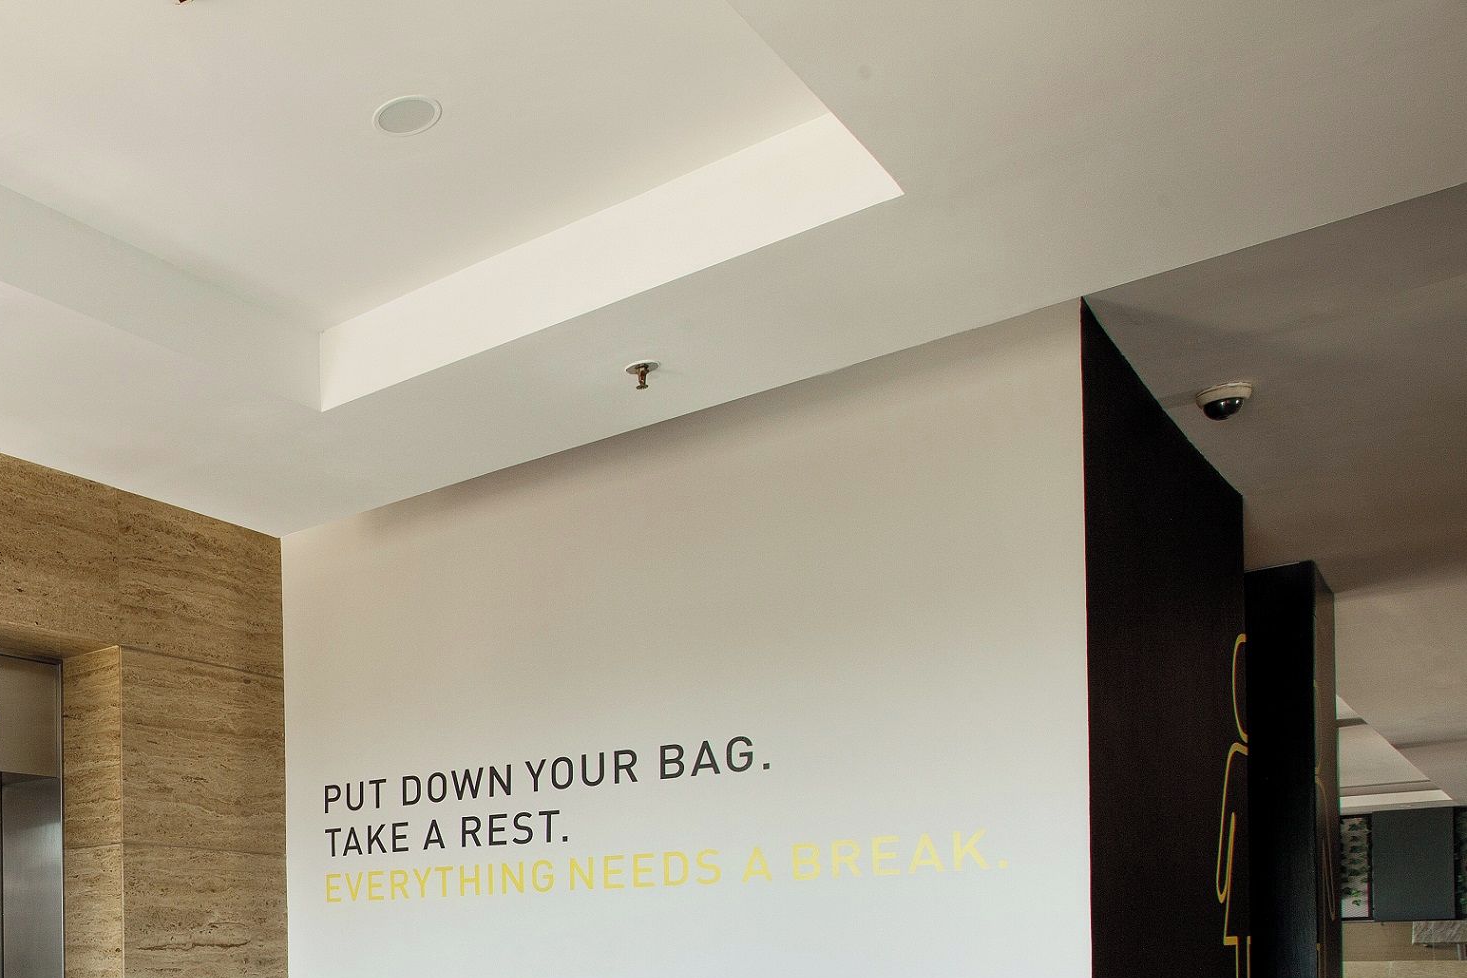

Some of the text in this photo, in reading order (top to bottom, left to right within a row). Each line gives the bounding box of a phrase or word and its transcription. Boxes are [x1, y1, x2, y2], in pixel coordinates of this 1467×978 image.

[324, 736, 771, 814] PUT DOWN YOUR BAG.
[325, 809, 569, 857] TAKE A REST.
[325, 826, 1009, 903] EVERYTHING NEEDS A BREAK.
